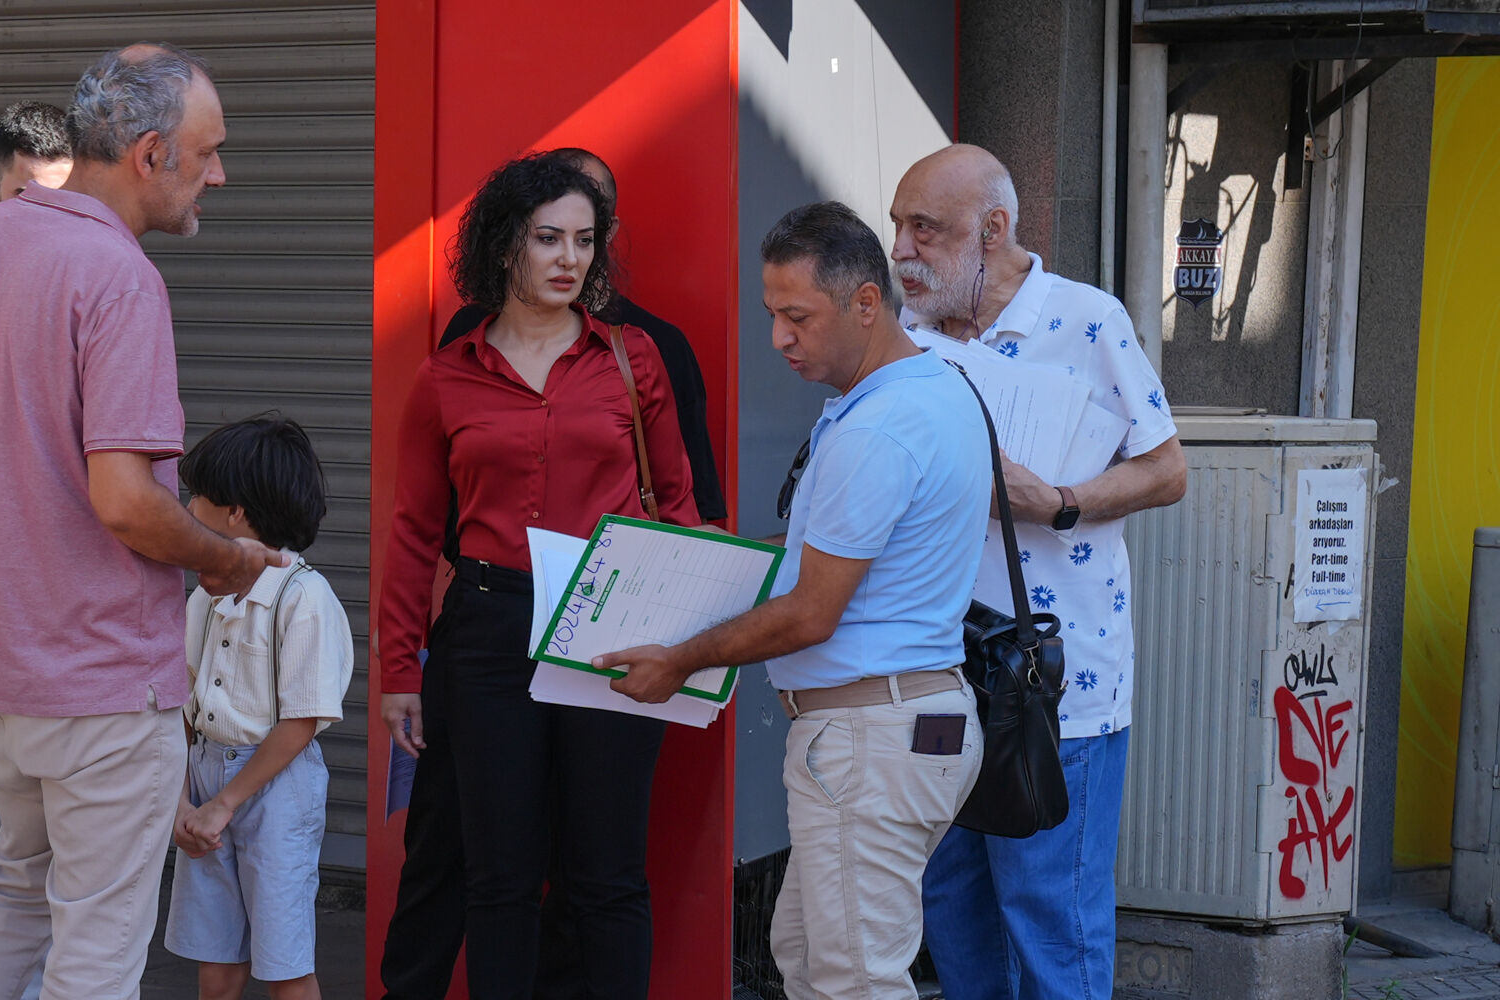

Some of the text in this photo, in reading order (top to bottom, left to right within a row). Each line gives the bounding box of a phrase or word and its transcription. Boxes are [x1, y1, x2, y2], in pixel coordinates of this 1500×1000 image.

[1179, 249, 1220, 263] AKKAYA
[1178, 267, 1218, 289] BUZ
[1316, 499, 1348, 514] Çalışma
[1308, 517, 1354, 534] arkadaşları
[1312, 536, 1347, 549] arıyoruz.
[1311, 552, 1348, 566] Part-time
[1311, 570, 1346, 583] Full-time
